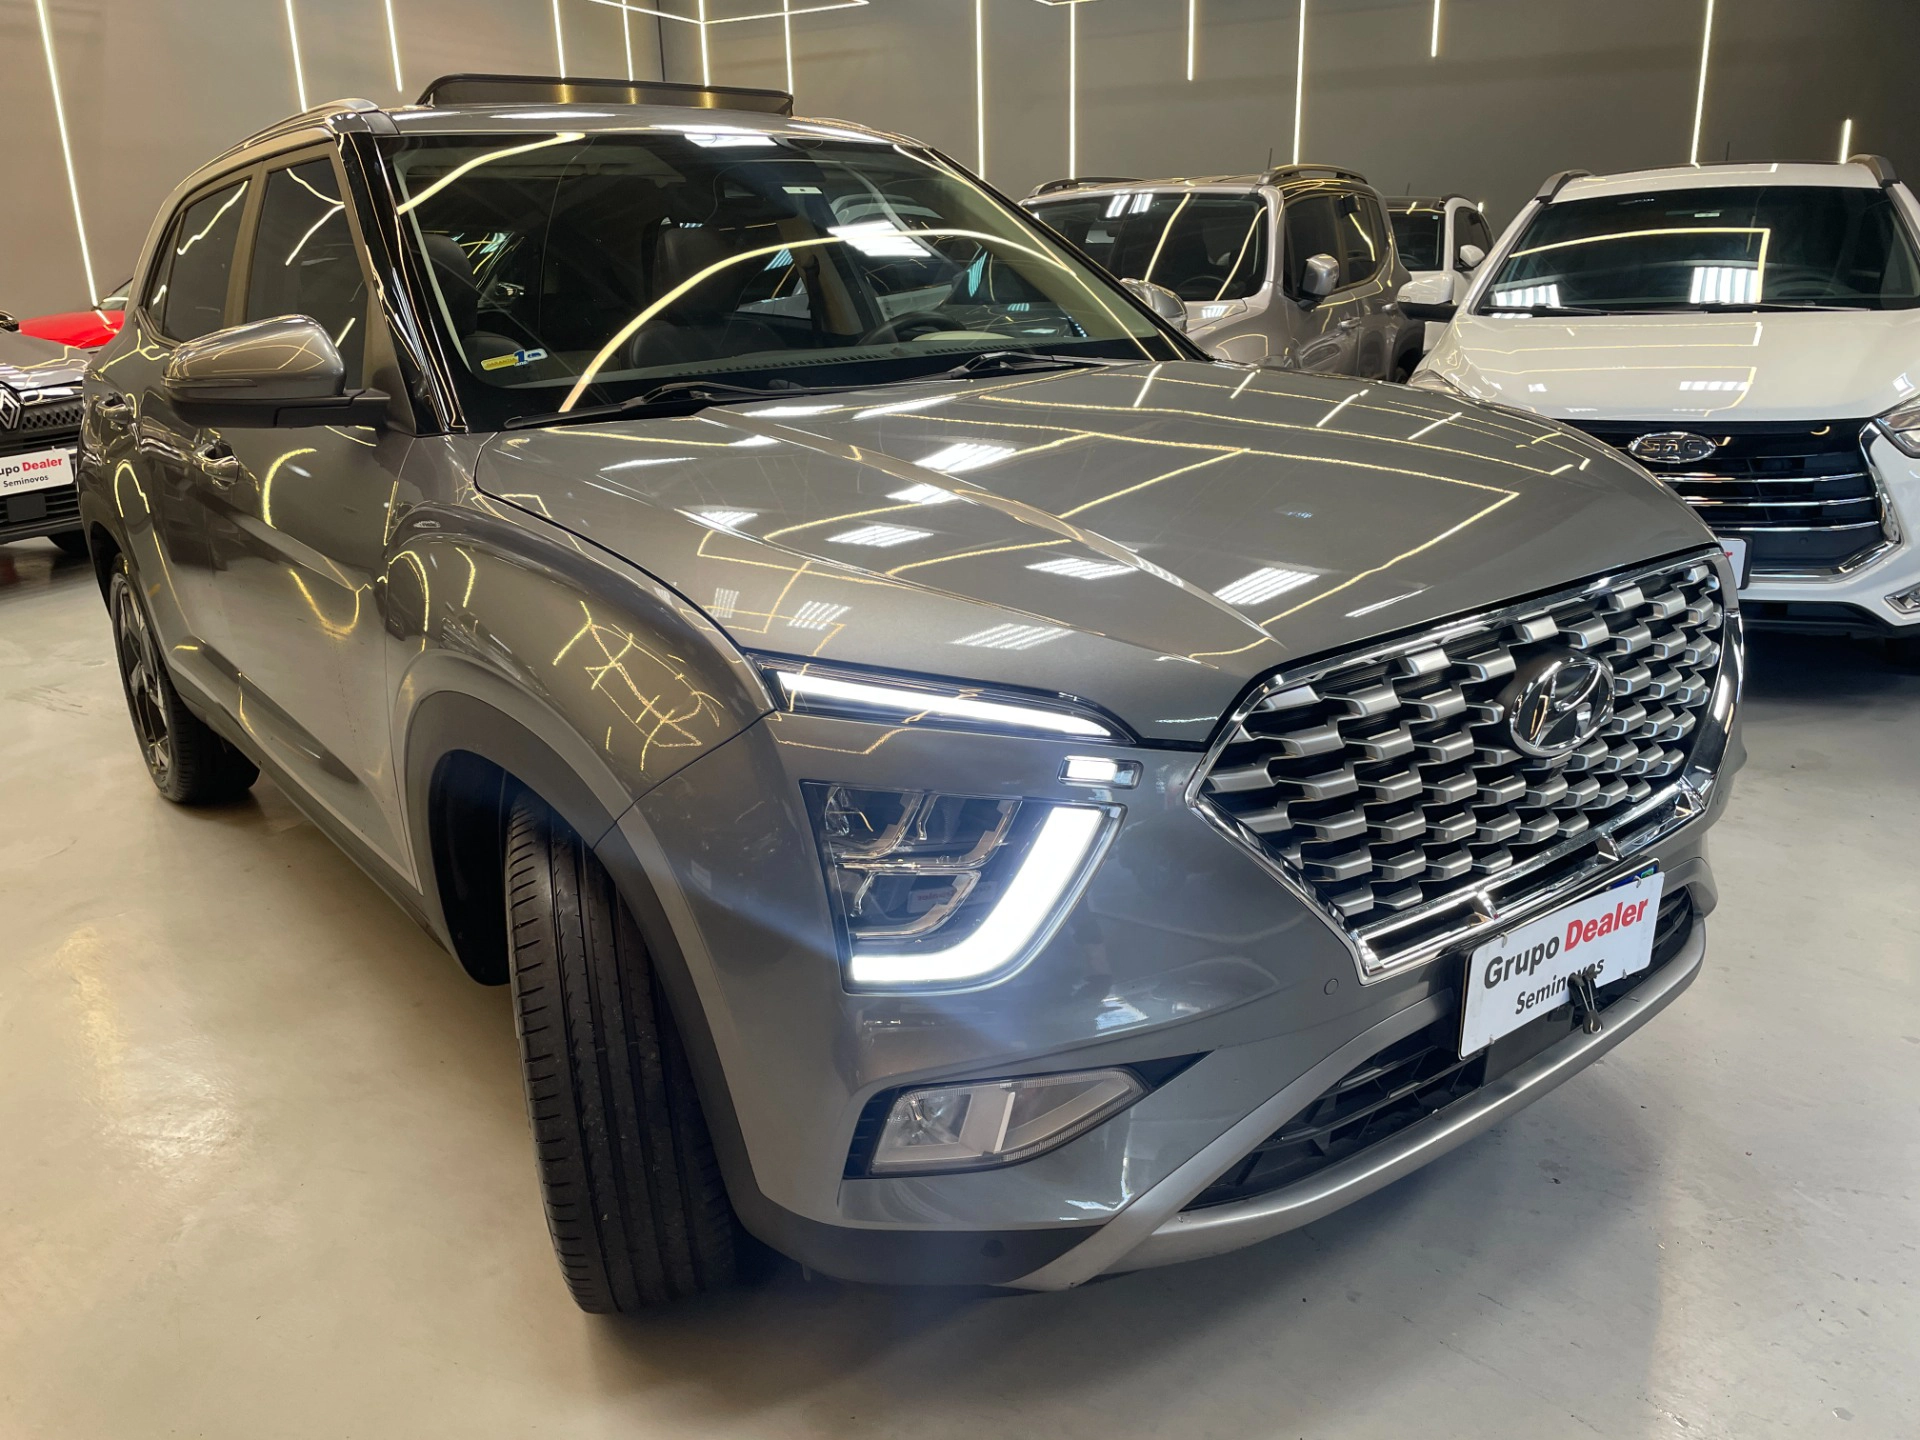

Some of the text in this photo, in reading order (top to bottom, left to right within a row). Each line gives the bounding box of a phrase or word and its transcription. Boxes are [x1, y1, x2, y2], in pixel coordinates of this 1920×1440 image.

[514, 351, 525, 362] 1
[0, 458, 62, 476] upo Dealer
[3, 475, 49, 487] Seminovos
[1484, 898, 1649, 989] Grupo Dealer
[1515, 958, 1605, 1015] Seminvs
